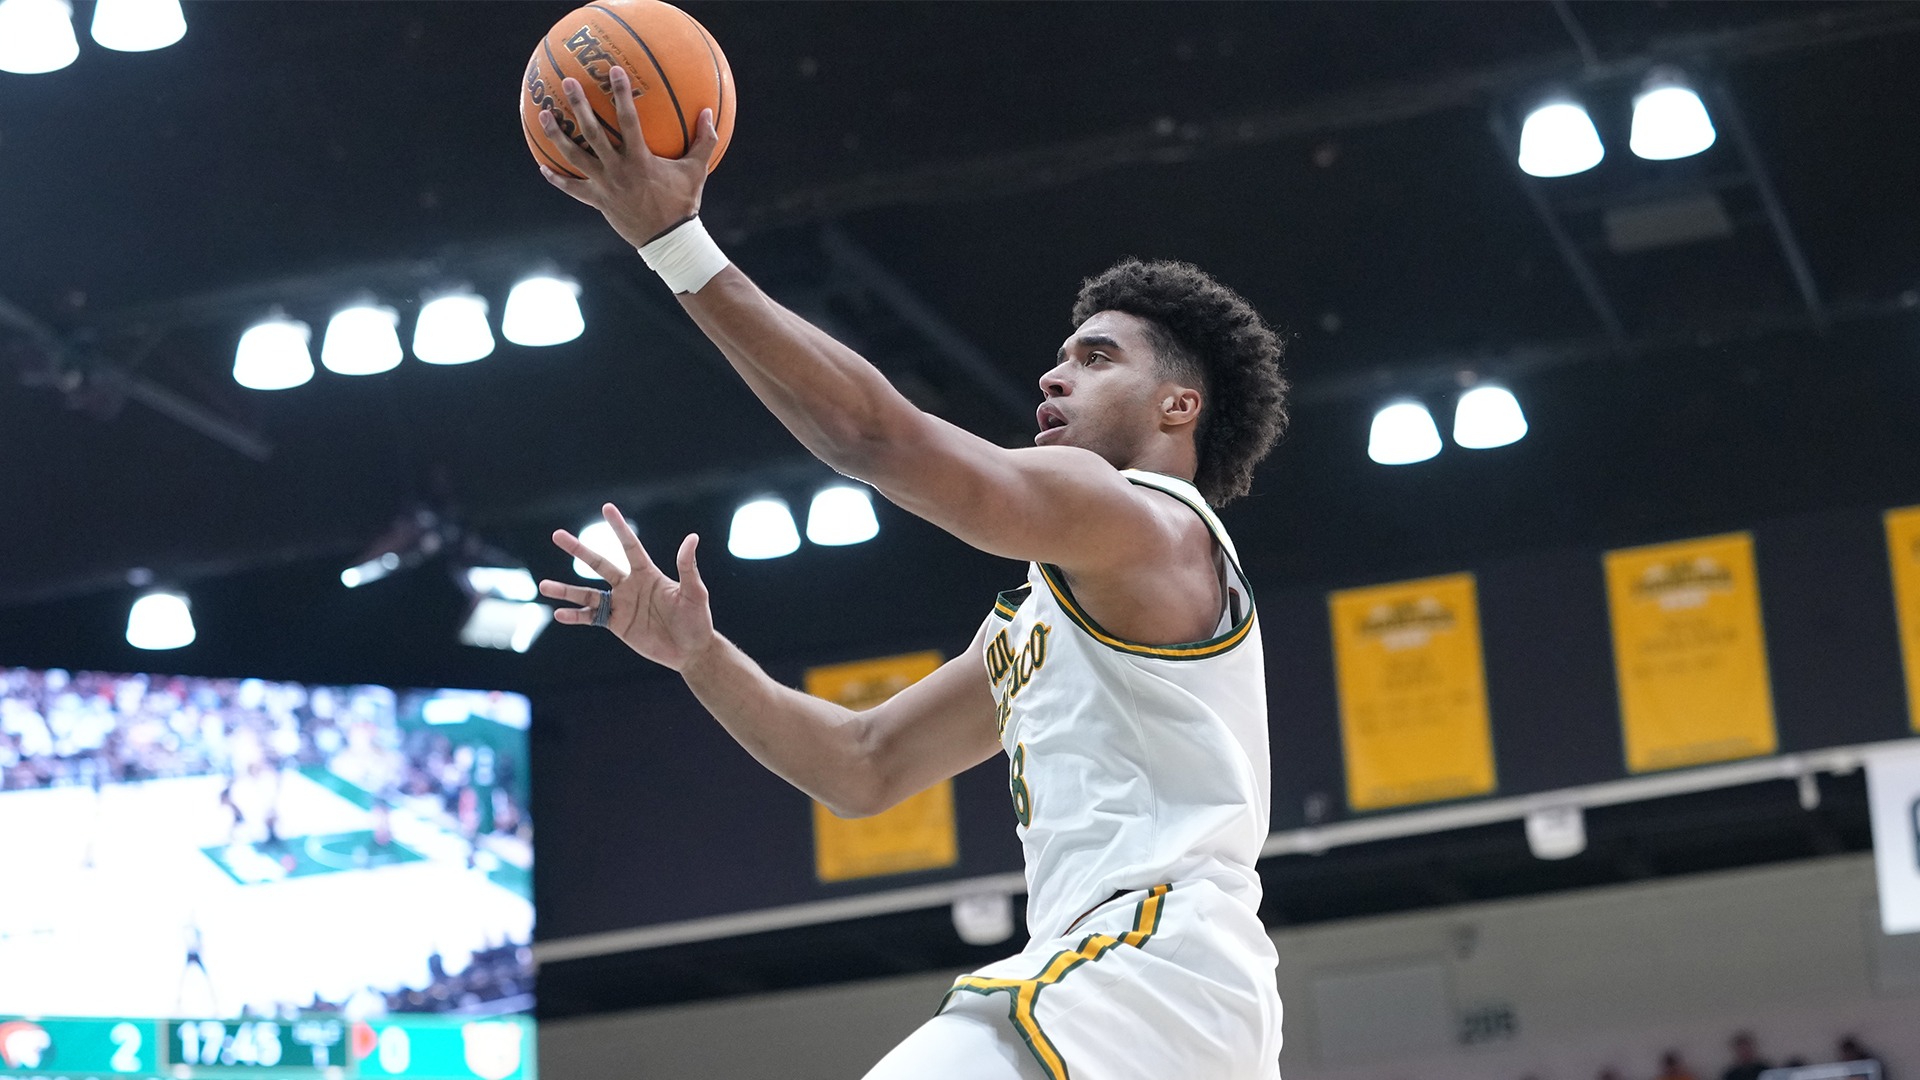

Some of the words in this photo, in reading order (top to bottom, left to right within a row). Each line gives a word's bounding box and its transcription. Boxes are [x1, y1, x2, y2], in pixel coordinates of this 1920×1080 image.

[986, 628, 1015, 687] an
[110, 1021, 142, 1072] 2
[176, 1021, 282, 1066] 17:45
[378, 1025, 410, 1074] 0
